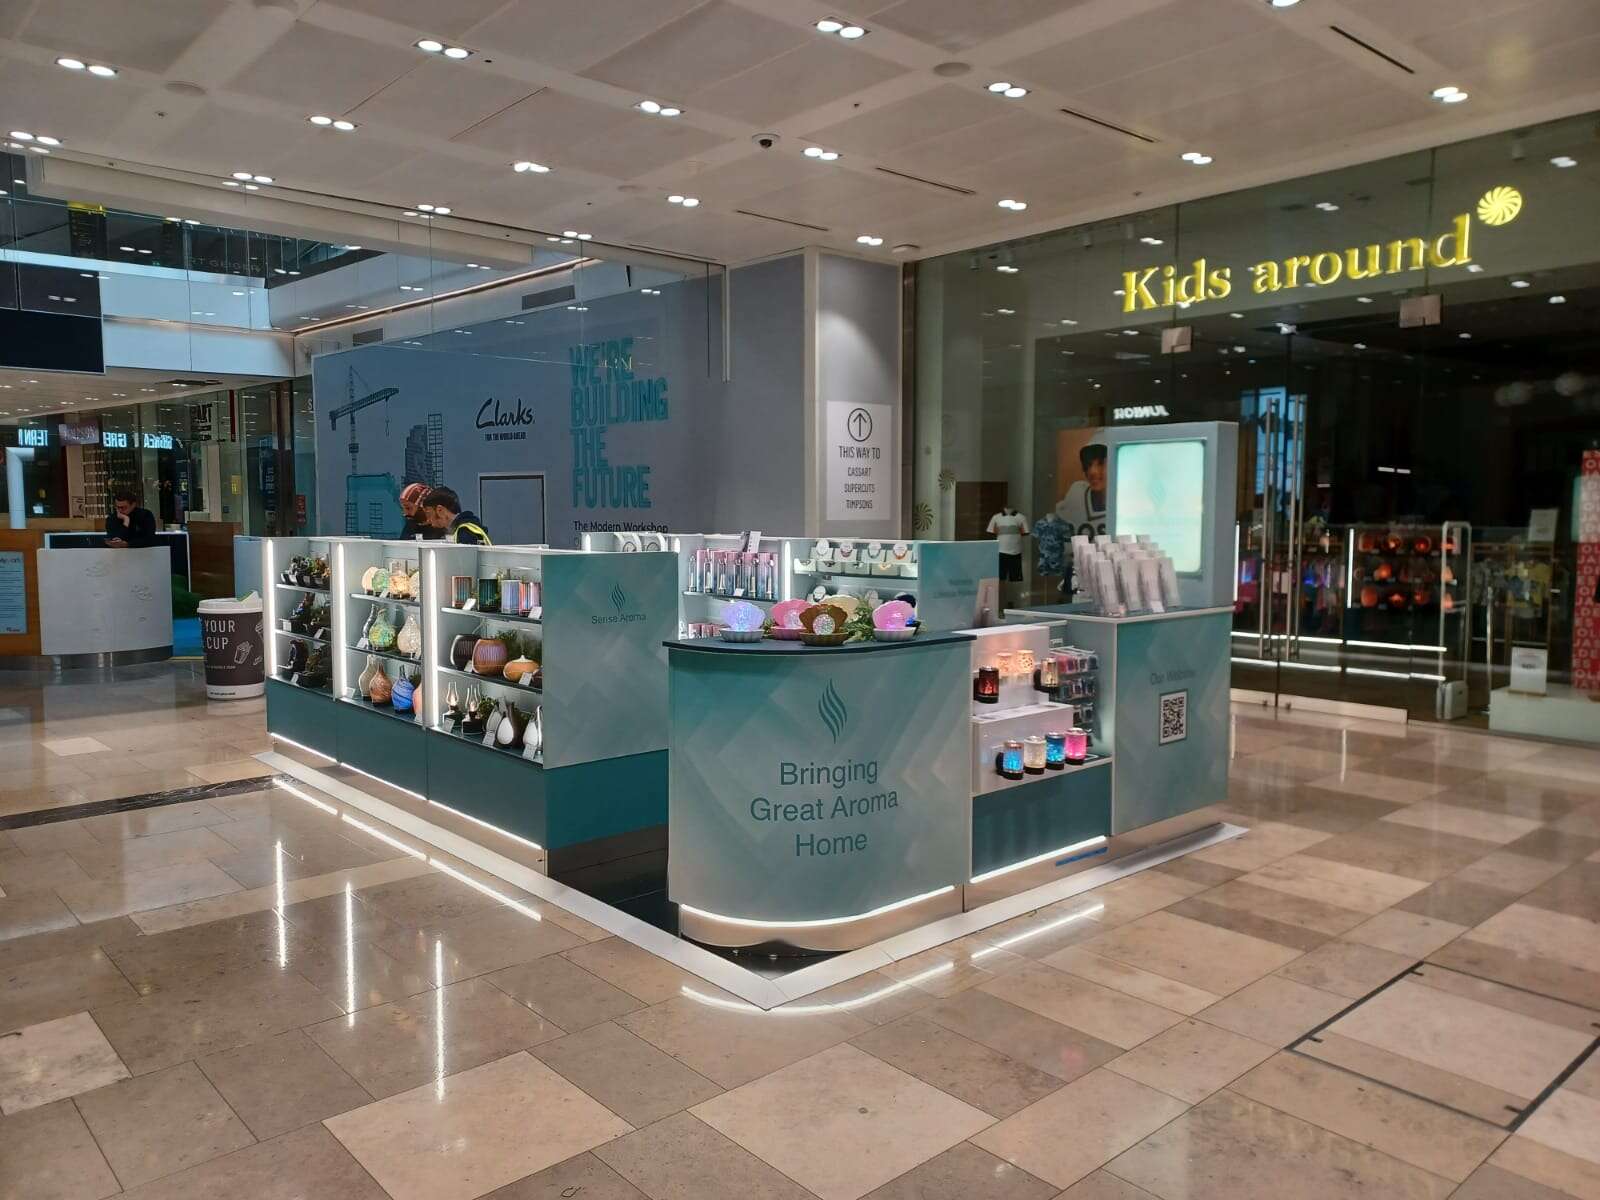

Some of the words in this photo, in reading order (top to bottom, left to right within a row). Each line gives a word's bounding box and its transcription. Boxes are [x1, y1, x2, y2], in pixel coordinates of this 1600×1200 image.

[1121, 258, 1232, 313] Kids
[1252, 213, 1473, 295] around
[569, 336, 635, 386] WE'RE
[475, 398, 536, 429] Clarks
[570, 376, 669, 428] BUILDING
[569, 425, 609, 469] THE
[838, 445, 855, 459] THIS
[856, 447, 870, 459] WAY
[872, 447, 881, 460] TO
[571, 463, 652, 510] FUTURE
[574, 520, 589, 531] The
[590, 521, 621, 533] Modern
[622, 521, 669, 534] Workshop
[204, 619, 236, 633] YOUR
[619, 613, 647, 624] Aroma
[206, 636, 229, 650] CUP
[779, 759, 878, 789] Bringing
[749, 796, 824, 822] Great
[830, 790, 898, 819] Aroma
[795, 832, 868, 857] Home
